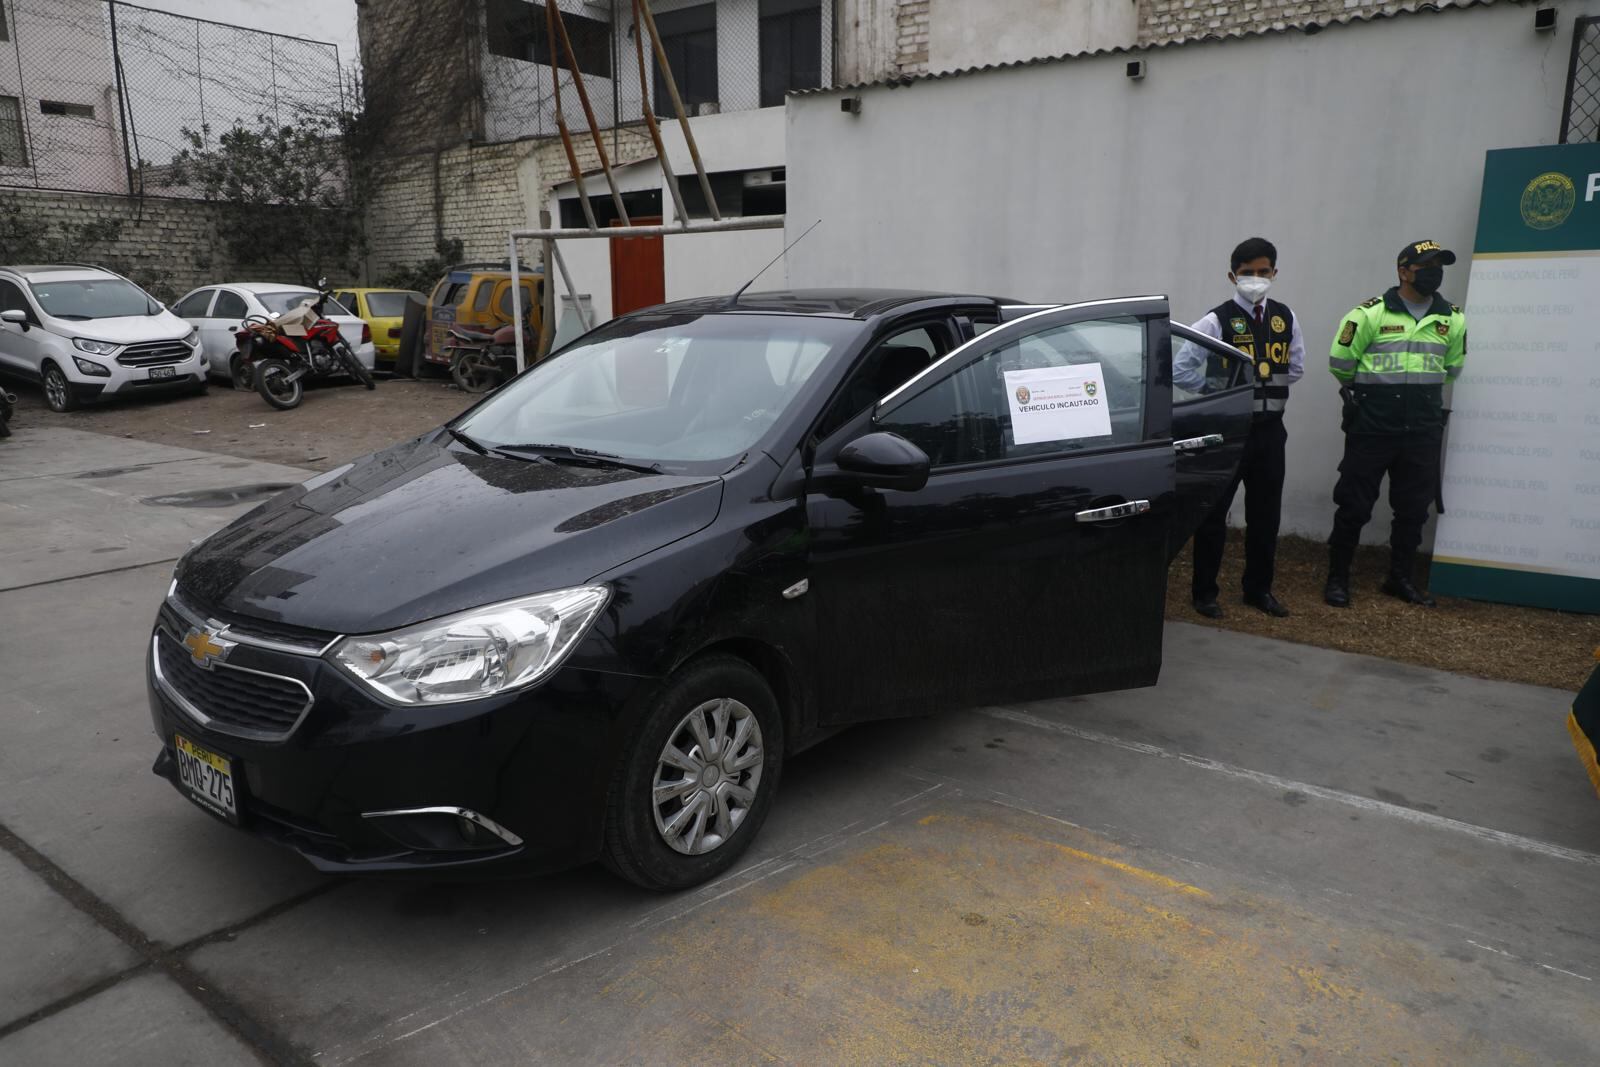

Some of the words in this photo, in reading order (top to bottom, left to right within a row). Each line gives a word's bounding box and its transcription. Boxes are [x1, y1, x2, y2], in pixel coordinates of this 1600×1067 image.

[1019, 403, 1056, 413] VEHICULO
[1057, 399, 1099, 409] INCAUTADO
[179, 748, 233, 807] BMQ-275
